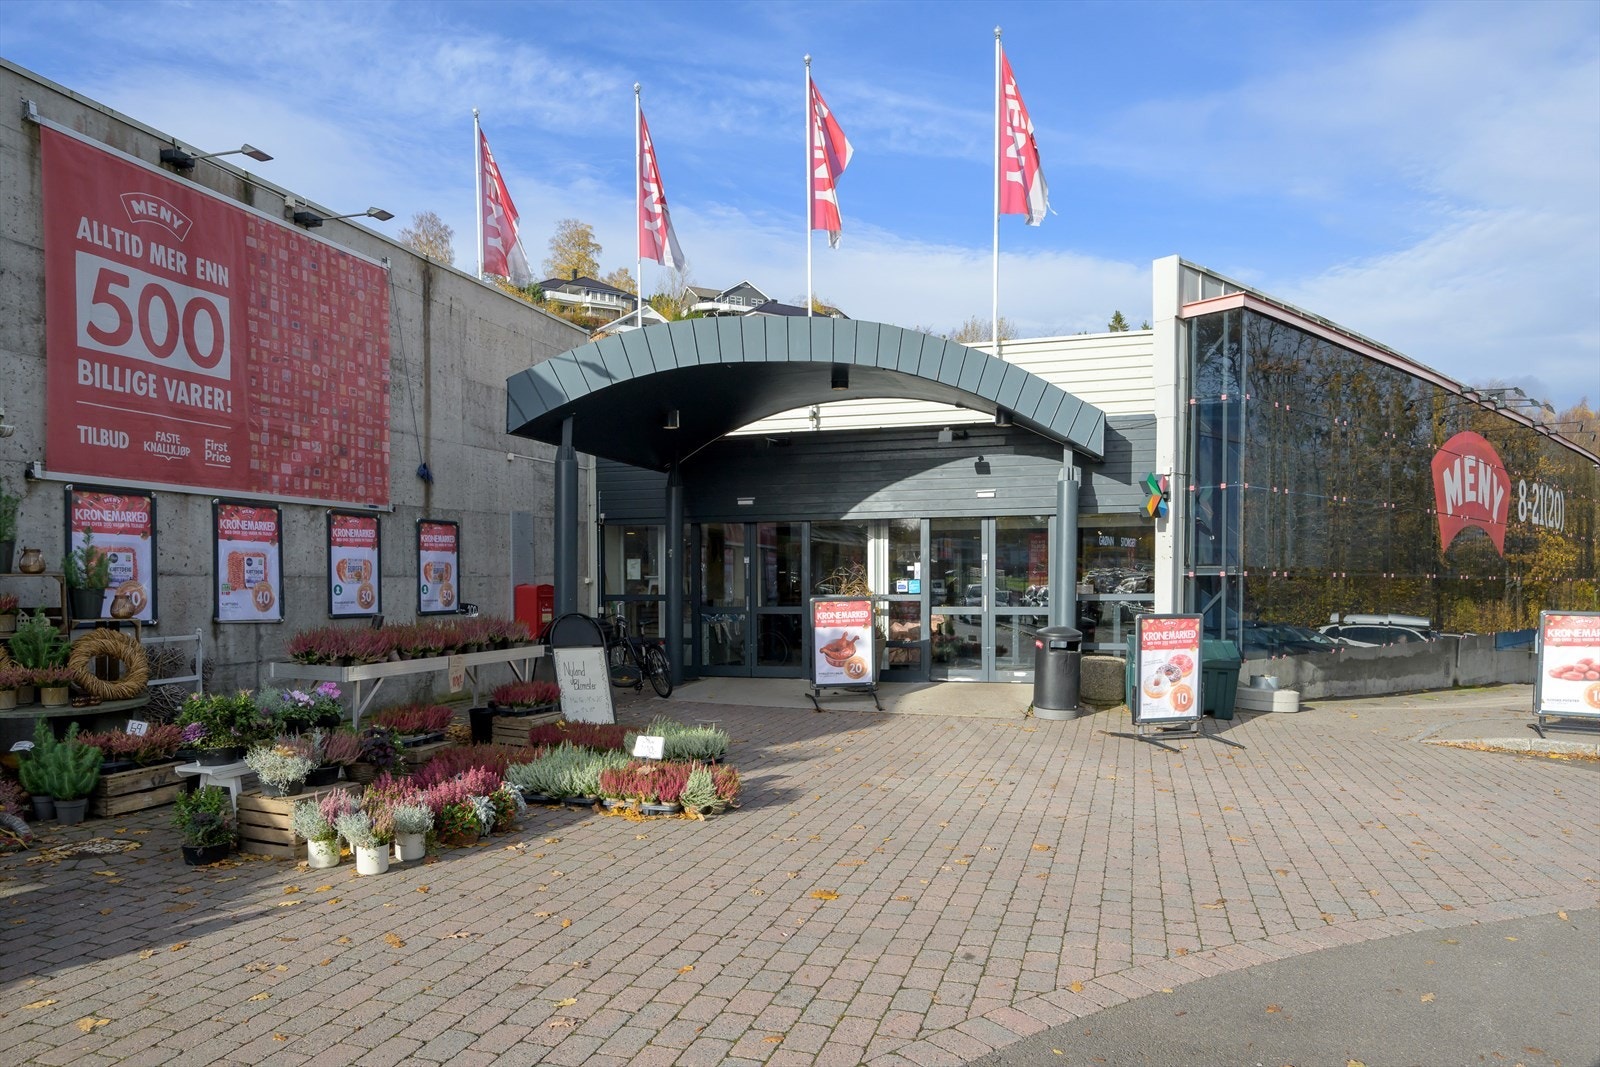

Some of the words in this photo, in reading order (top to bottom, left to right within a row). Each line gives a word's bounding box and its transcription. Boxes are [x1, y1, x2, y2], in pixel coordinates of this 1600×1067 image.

[130, 199, 184, 230] MENY
[76, 216, 143, 259] ALLTID
[150, 242, 188, 275] MER
[196, 257, 229, 288] ENN
[86, 267, 225, 369] 500
[77, 358, 157, 398] BILLIGE
[163, 377, 232, 413] VARER!
[77, 425, 130, 449] TILBUD
[155, 431, 180, 444] FASTE
[143, 441, 191, 457] KNALLKJØP
[205, 438, 228, 452] First
[205, 450, 231, 463] Price
[1443, 455, 1504, 523] MENY
[1517, 479, 1565, 532] 8-21(20)
[74, 508, 149, 523] KRONEMARKED
[219, 519, 276, 532] KRONEMARKED
[332, 528, 376, 539] KRONEMARKED
[257, 591, 270, 604] 40
[361, 590, 372, 602] 30
[816, 610, 869, 620] KRONEMARKED
[1142, 629, 1197, 641] KRONEMARKED
[849, 663, 863, 673] 20
[1176, 692, 1188, 704] 10
